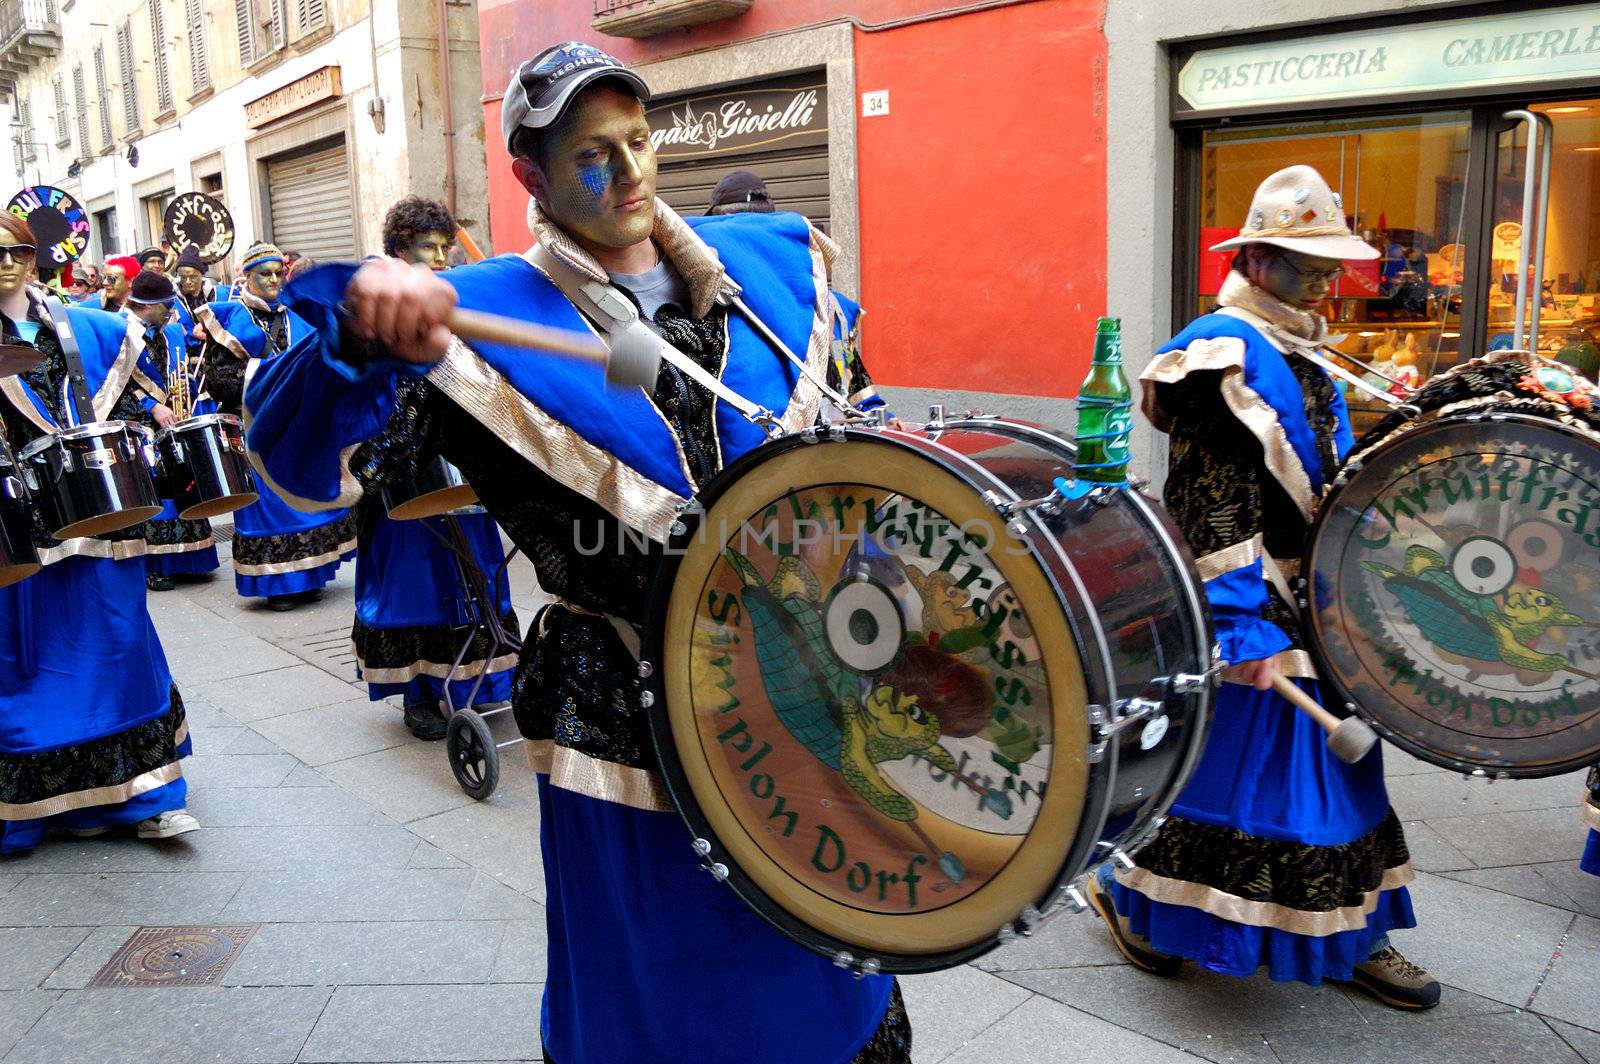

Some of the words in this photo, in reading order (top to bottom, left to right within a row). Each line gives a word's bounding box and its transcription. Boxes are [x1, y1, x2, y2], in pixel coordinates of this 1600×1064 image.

[547, 57, 614, 83] LIEBHERR
[1197, 46, 1388, 93] PASTICCERIA
[648, 116, 703, 152] gaso
[718, 89, 818, 139] Gioielli
[869, 97, 883, 112] 34
[1488, 678, 1582, 728] Dorf
[708, 589, 798, 838] Simplon
[810, 823, 928, 908] Dorf
